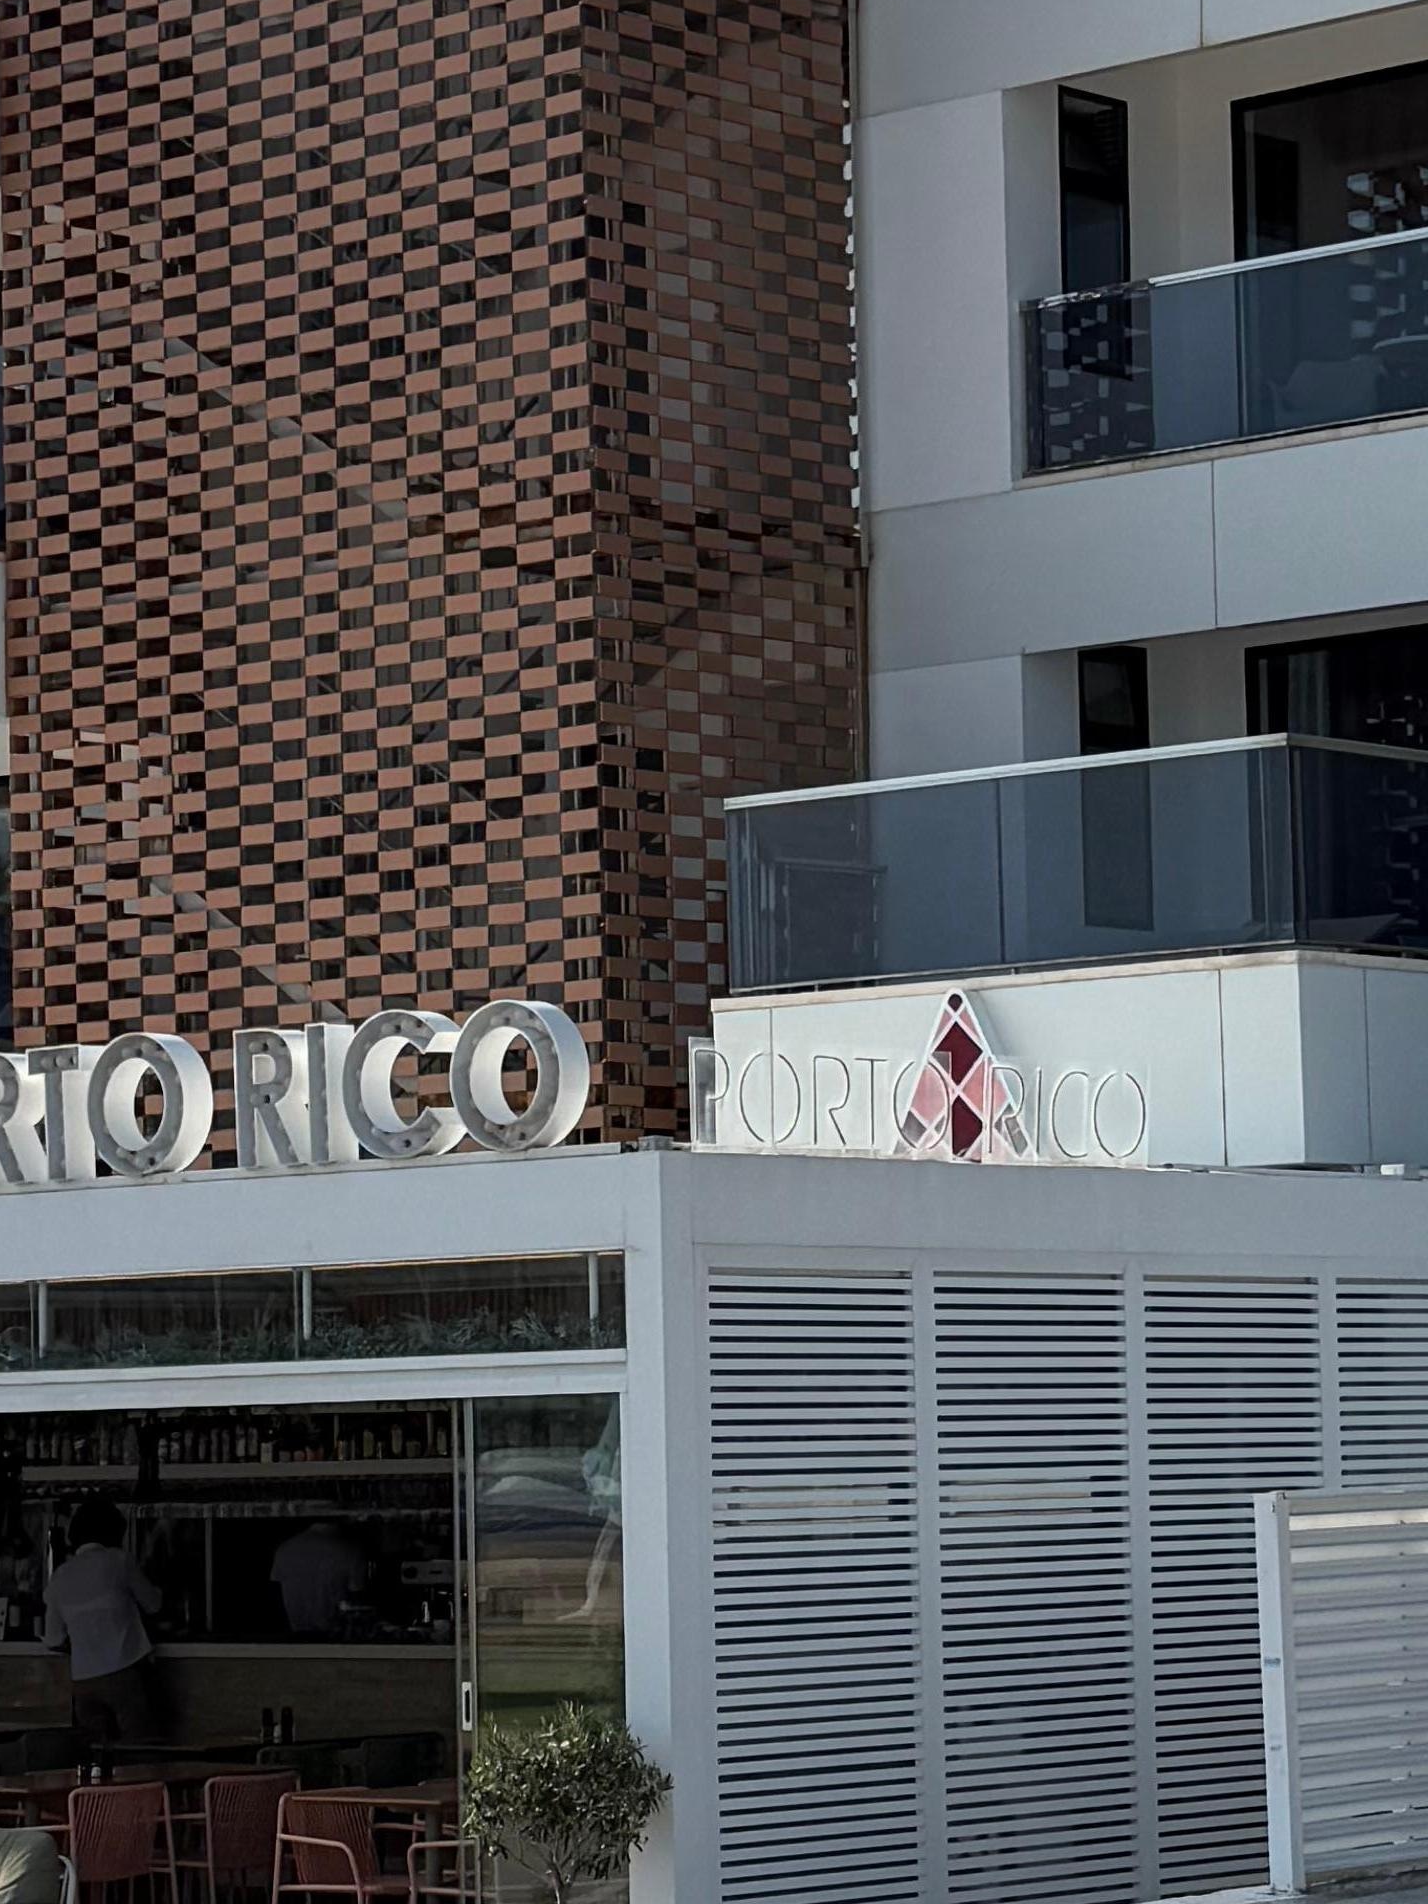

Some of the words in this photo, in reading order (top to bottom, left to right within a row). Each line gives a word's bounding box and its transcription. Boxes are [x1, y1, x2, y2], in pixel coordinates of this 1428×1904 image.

[234, 998, 591, 1170] RICO
[692, 1048, 950, 1151] PORTO
[987, 1062, 1147, 1160] RICO
